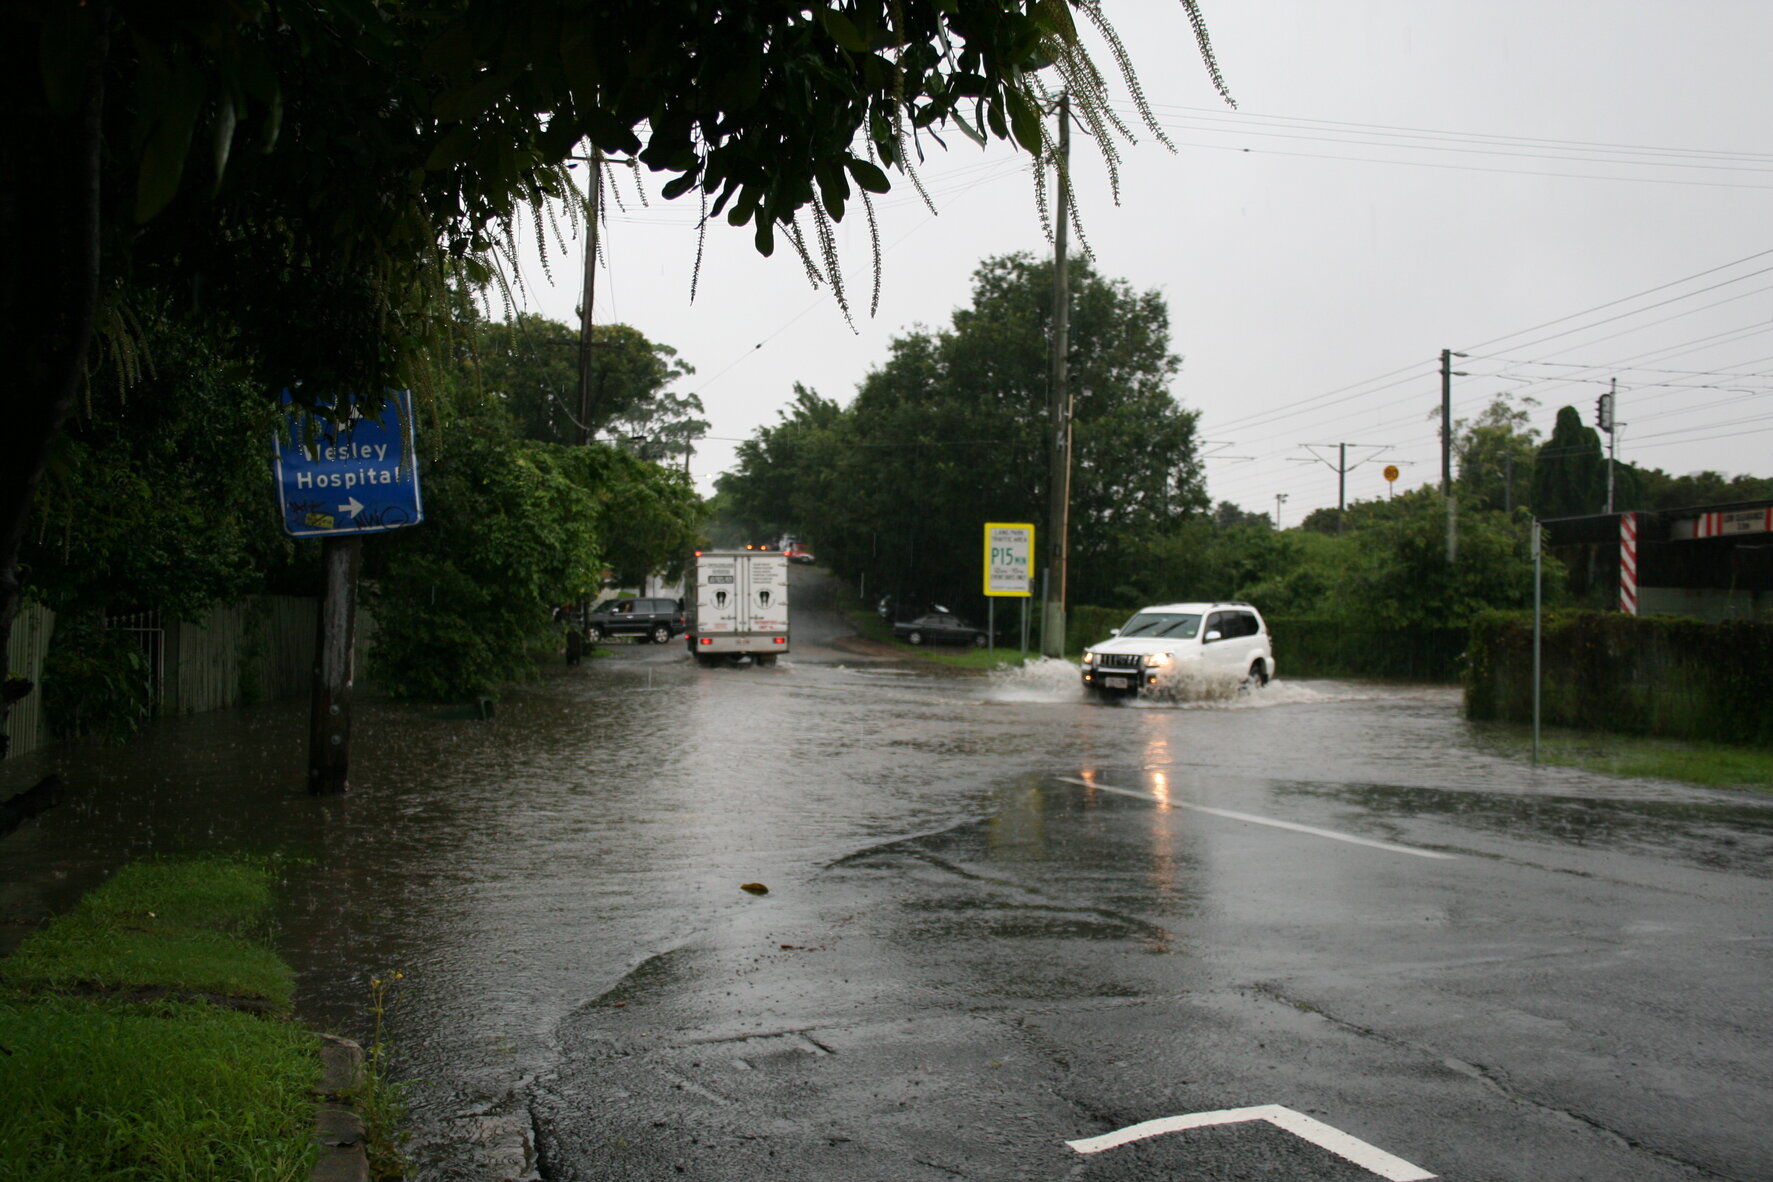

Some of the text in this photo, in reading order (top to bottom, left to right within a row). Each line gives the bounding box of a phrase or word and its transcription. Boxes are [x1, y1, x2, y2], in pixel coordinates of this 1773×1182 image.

[303, 442, 387, 462] Wesley
[297, 466, 400, 489] Hospital
[992, 547, 1013, 566] P15
